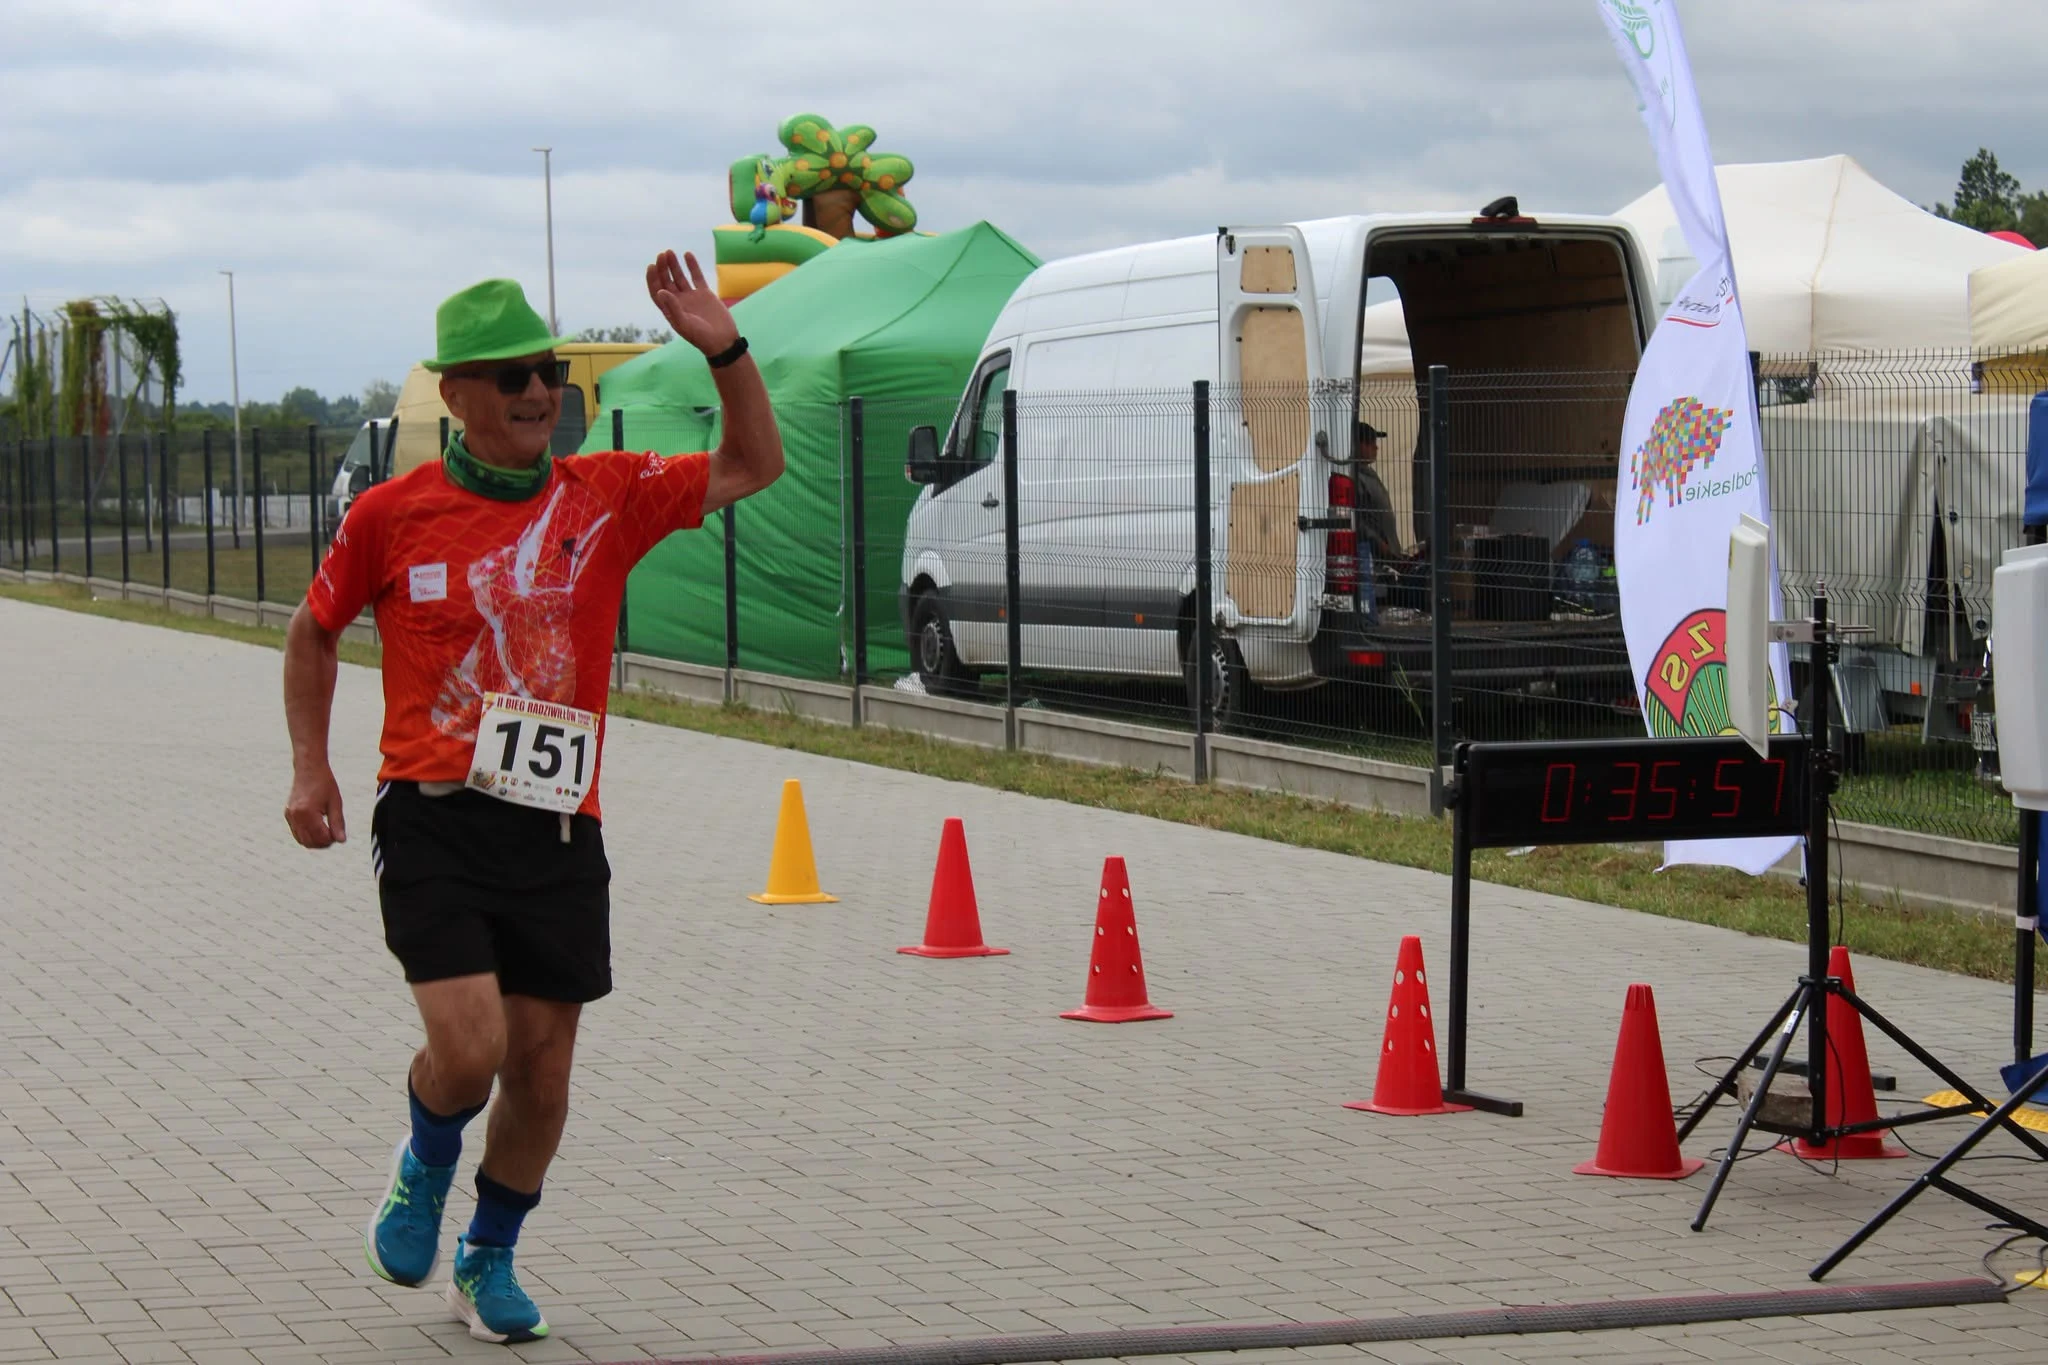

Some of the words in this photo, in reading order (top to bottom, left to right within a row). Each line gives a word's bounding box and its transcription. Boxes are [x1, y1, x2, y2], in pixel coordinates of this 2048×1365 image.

[497, 696, 504, 708] II
[505, 698, 525, 710] BIEG
[496, 720, 585, 785] 151
[1541, 758, 1785, 823] 0:35:57
